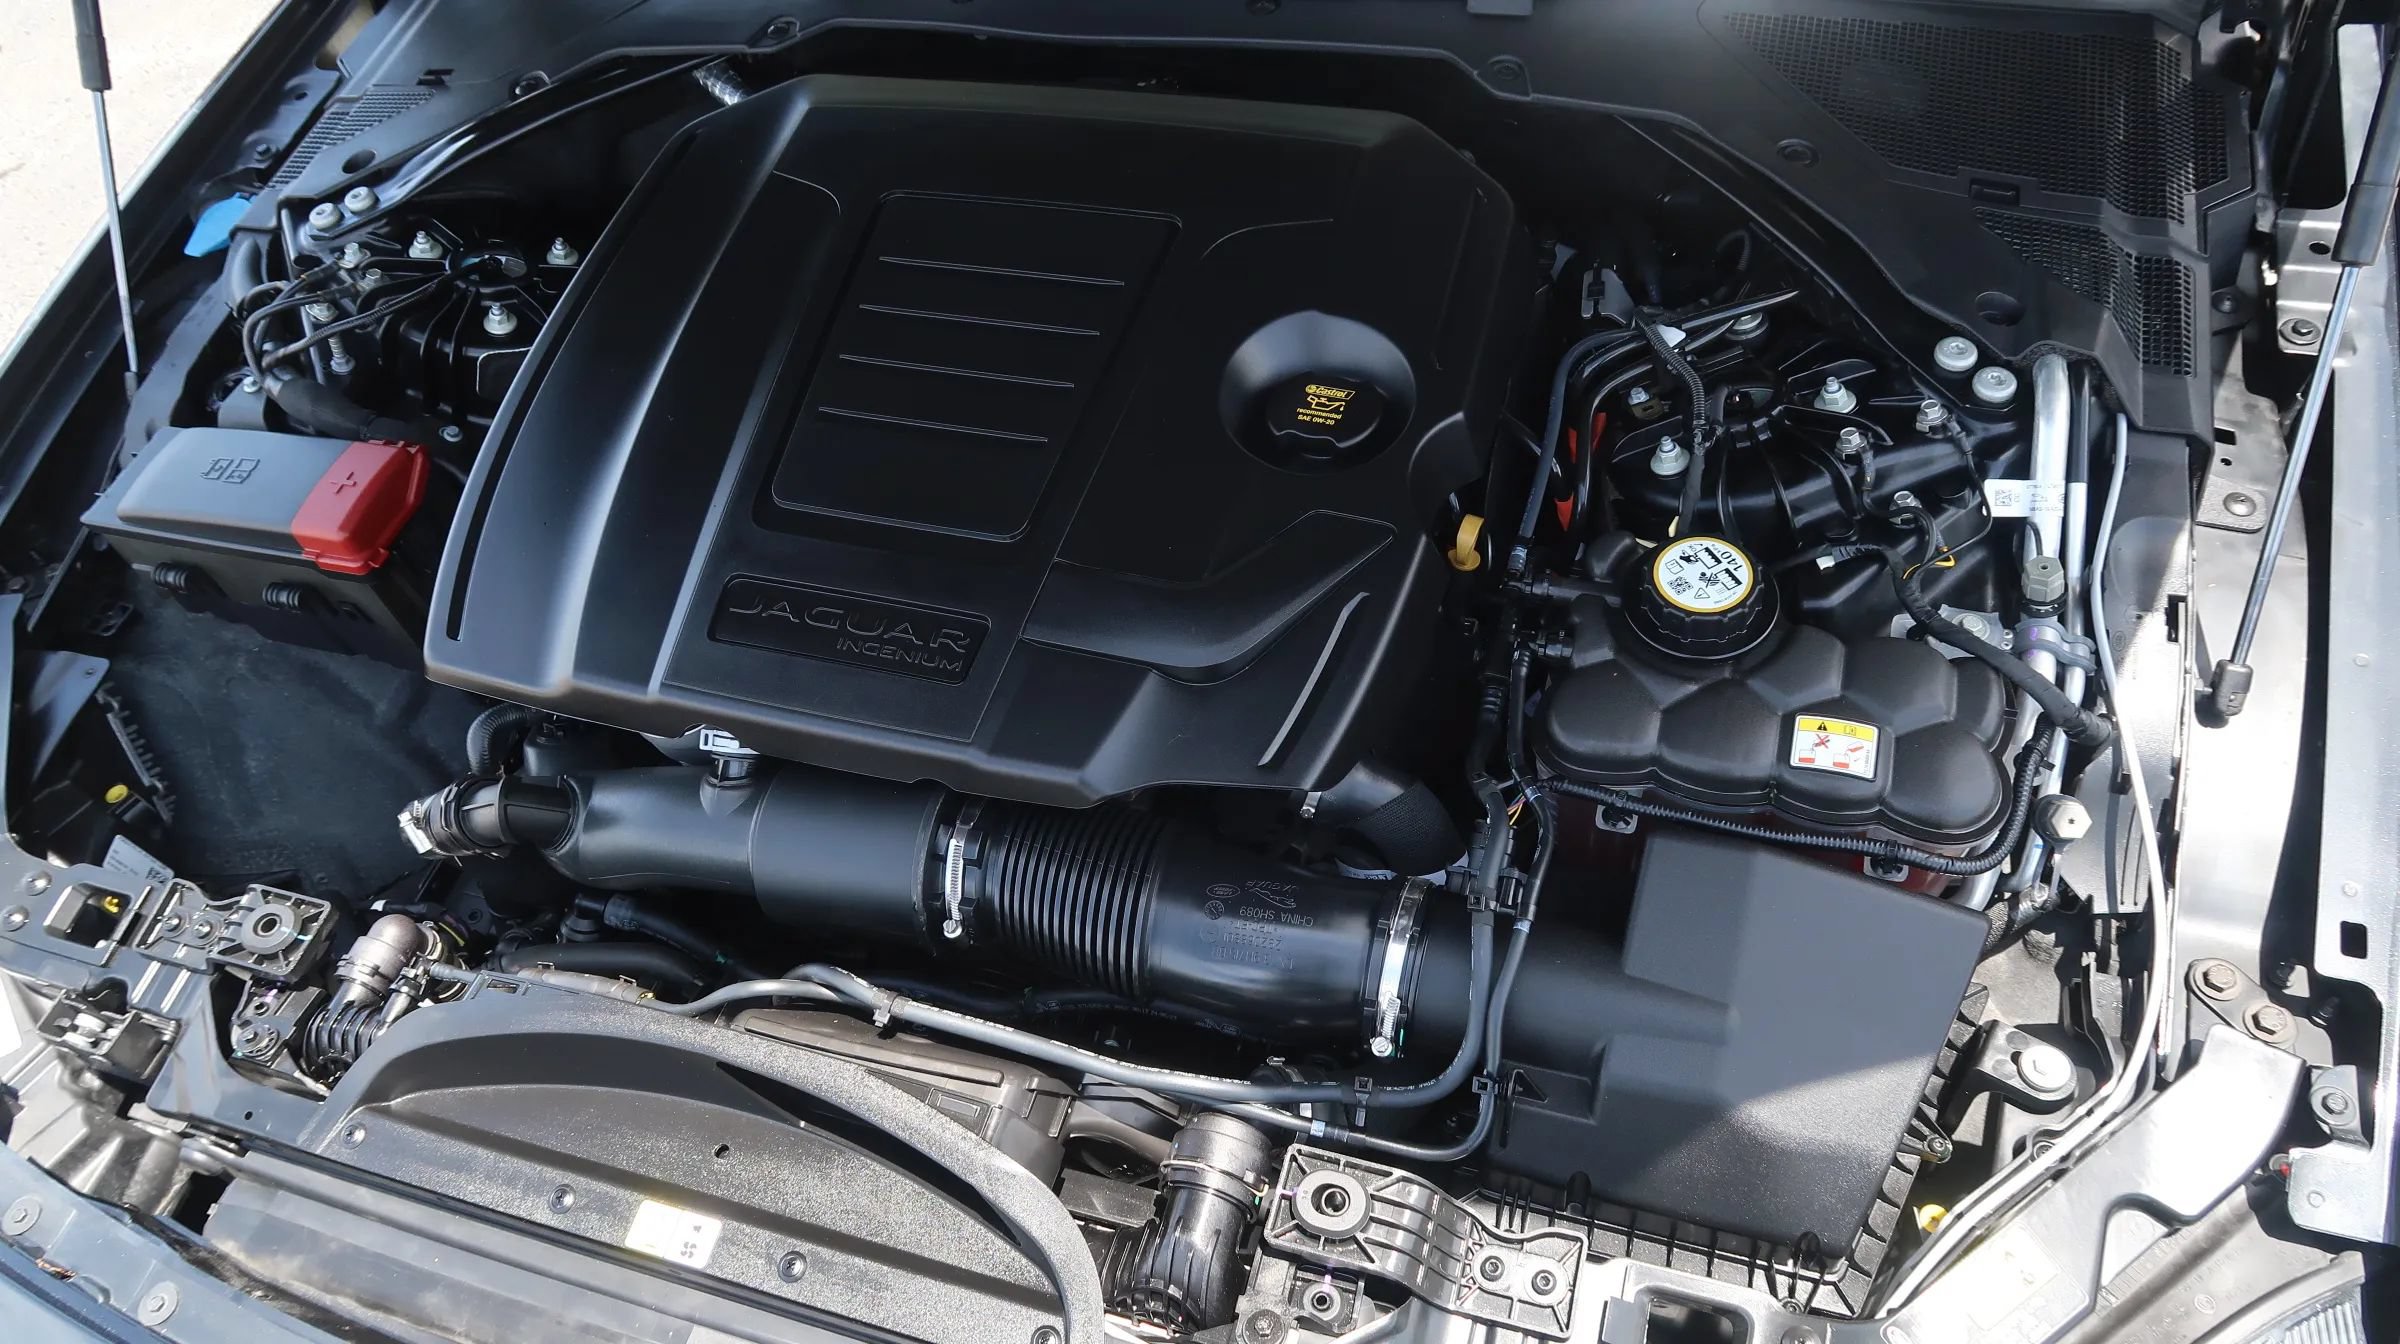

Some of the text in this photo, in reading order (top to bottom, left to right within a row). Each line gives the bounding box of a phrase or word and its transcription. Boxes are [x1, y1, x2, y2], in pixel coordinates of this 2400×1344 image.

[1315, 387, 1348, 398] Castrol
[1296, 408, 1343, 420] recommended
[1297, 414, 1335, 426] SAE 0W-20
[1720, 550, 1744, 572] 140
[729, 595, 971, 653] JAGUAR
[836, 636, 964, 672] INGENIUM
[1239, 905, 1315, 928] CHINA SH089
